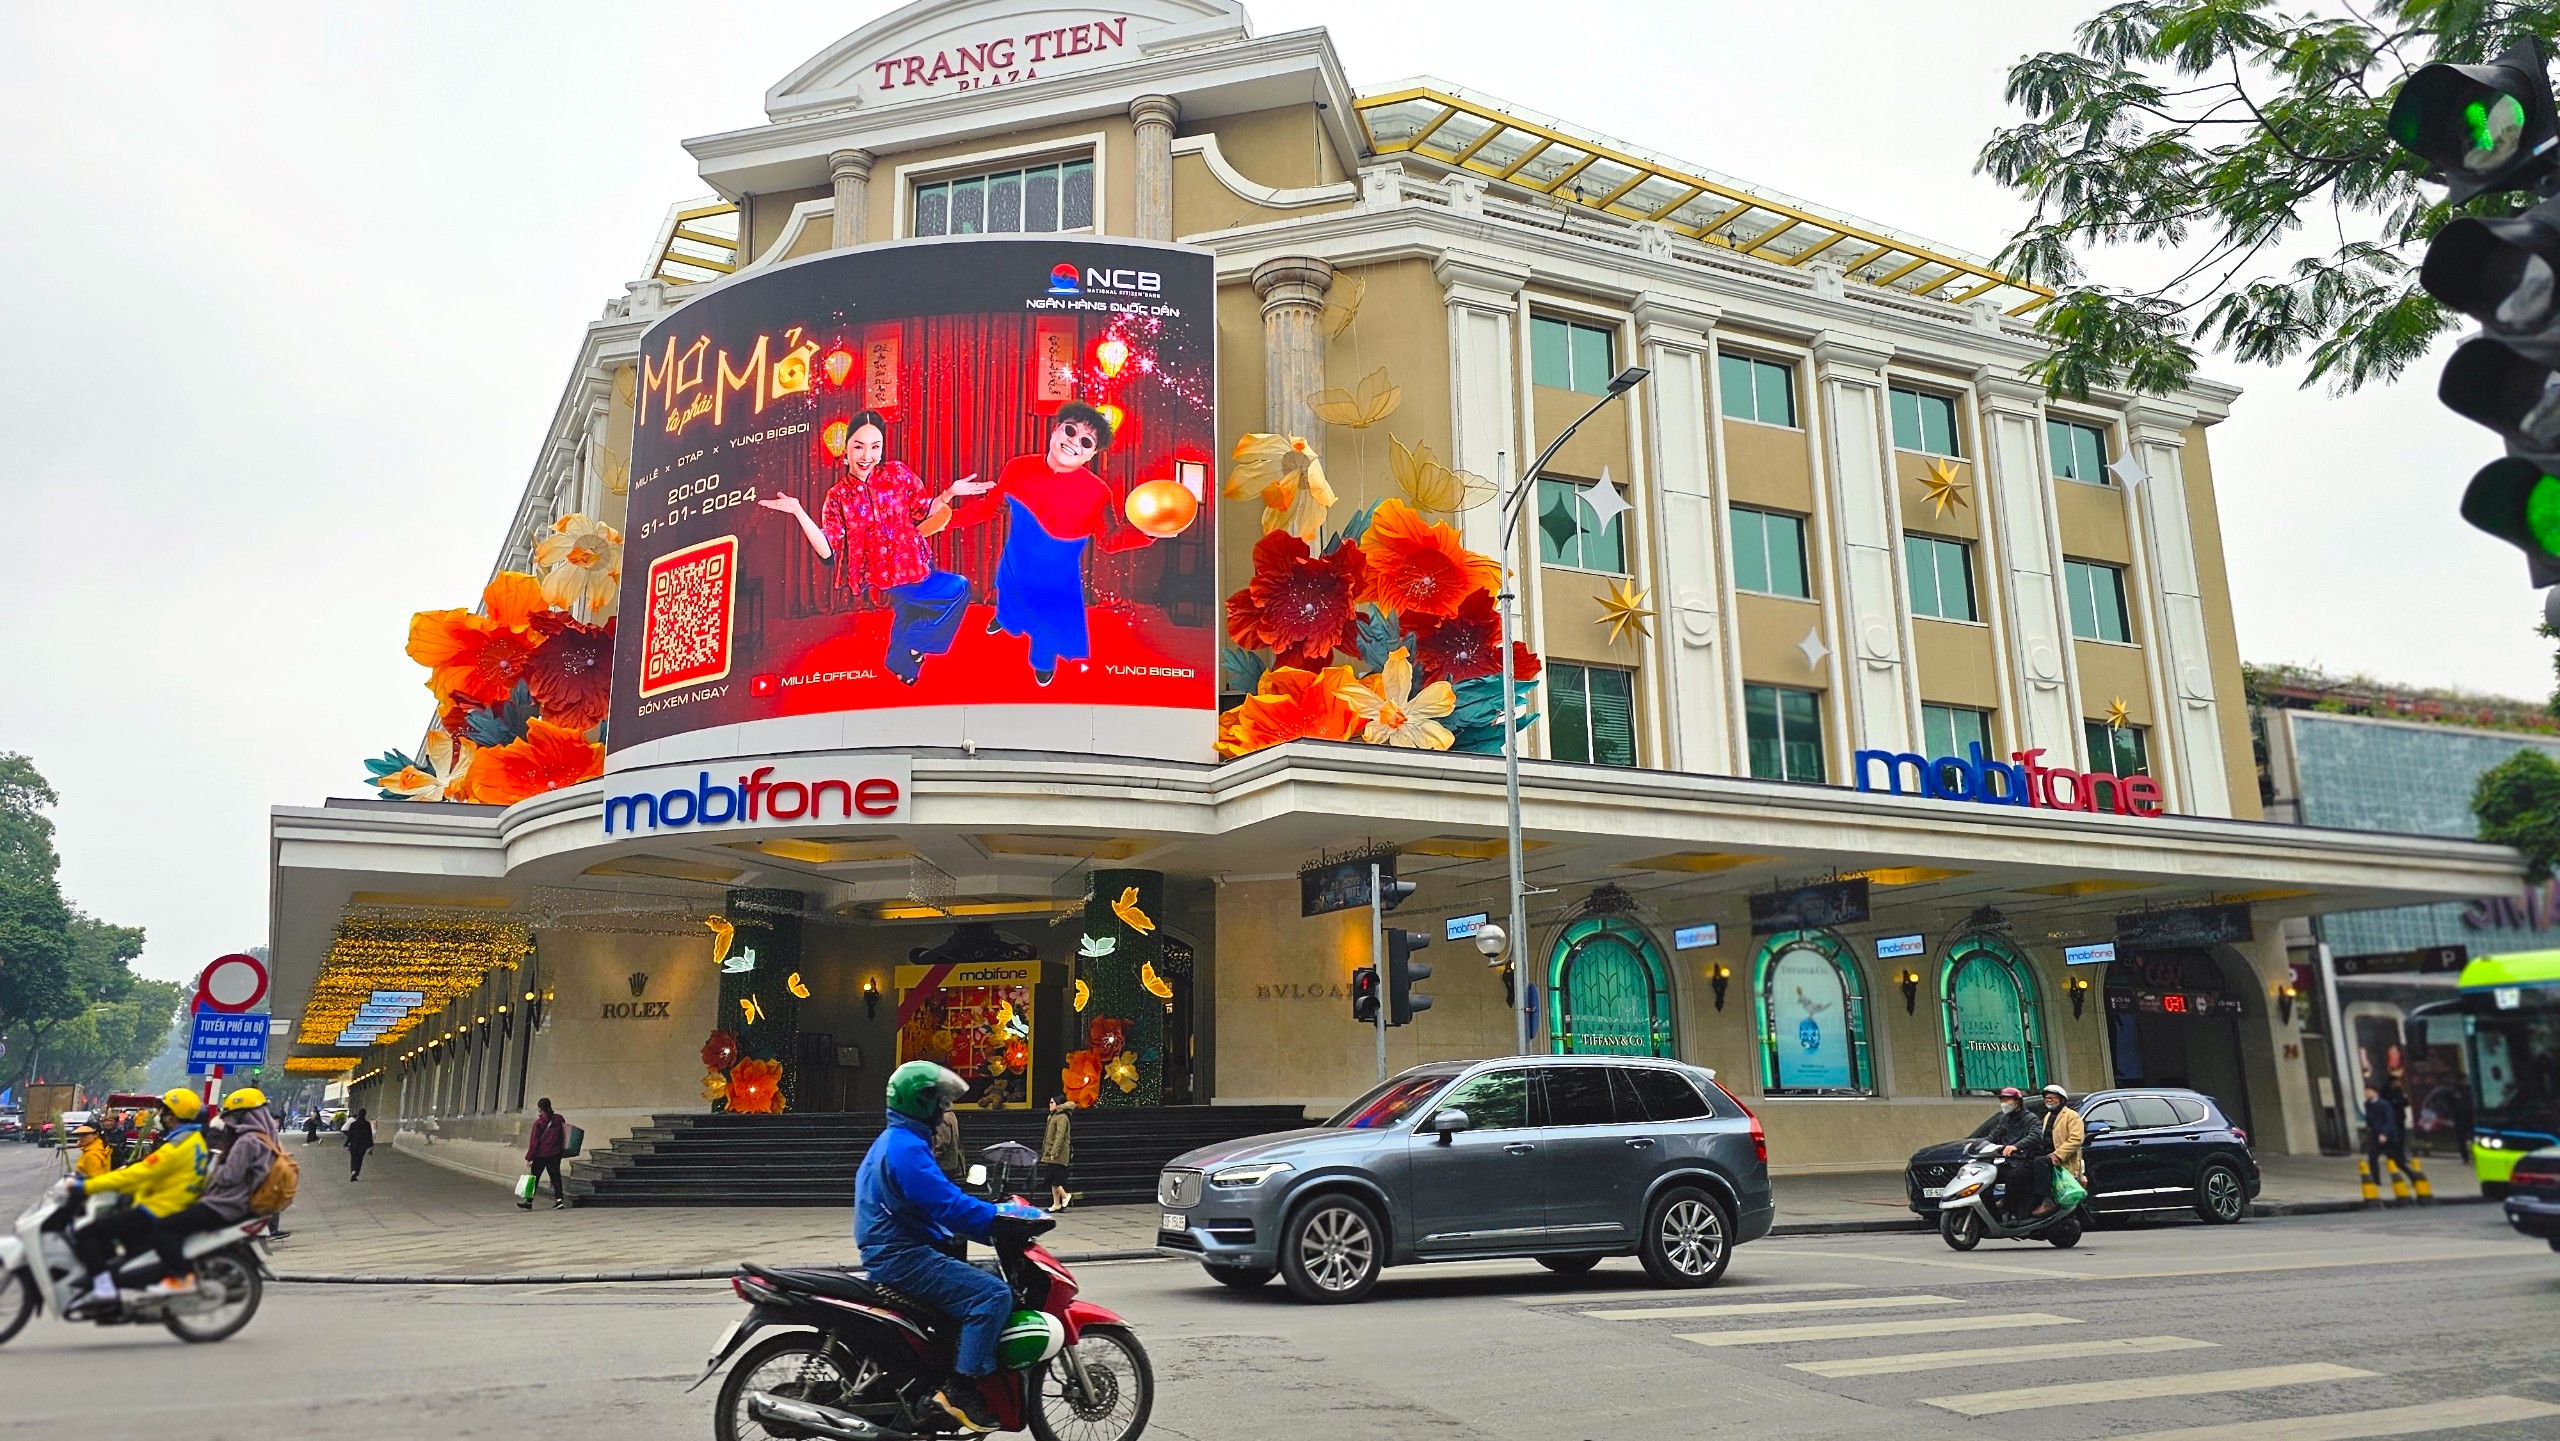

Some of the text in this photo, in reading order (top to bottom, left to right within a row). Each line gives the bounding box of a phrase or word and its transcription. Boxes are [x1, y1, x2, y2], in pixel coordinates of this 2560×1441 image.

[875, 17, 1127, 90] TRANG TIEN
[1087, 267, 1161, 292] NCB
[1026, 298, 1065, 309] NGÂN
[1068, 298, 1107, 311] HÀNG
[635, 477, 649, 490] MIU
[649, 468, 659, 481] LÊ
[678, 450, 704, 467] DTAP
[667, 474, 720, 505] 20:00
[781, 669, 877, 688] MIU LÊ OFFICIAL
[1105, 665, 1195, 679] YUNO BIGBOI
[638, 685, 729, 717] ĐÓN XEM NGAY
[1855, 741, 2164, 818] mobifone
[604, 766, 900, 835] mobifone
[1879, 941, 1923, 955] mobifone
[2067, 948, 2114, 962] mobifone
[960, 967, 1028, 981] mobifone
[1256, 982, 1353, 999] BVLGA
[601, 1002, 670, 1018] ROLEX
[200, 1017, 265, 1035] TUYẾN PHỐ ĐI BỘ
